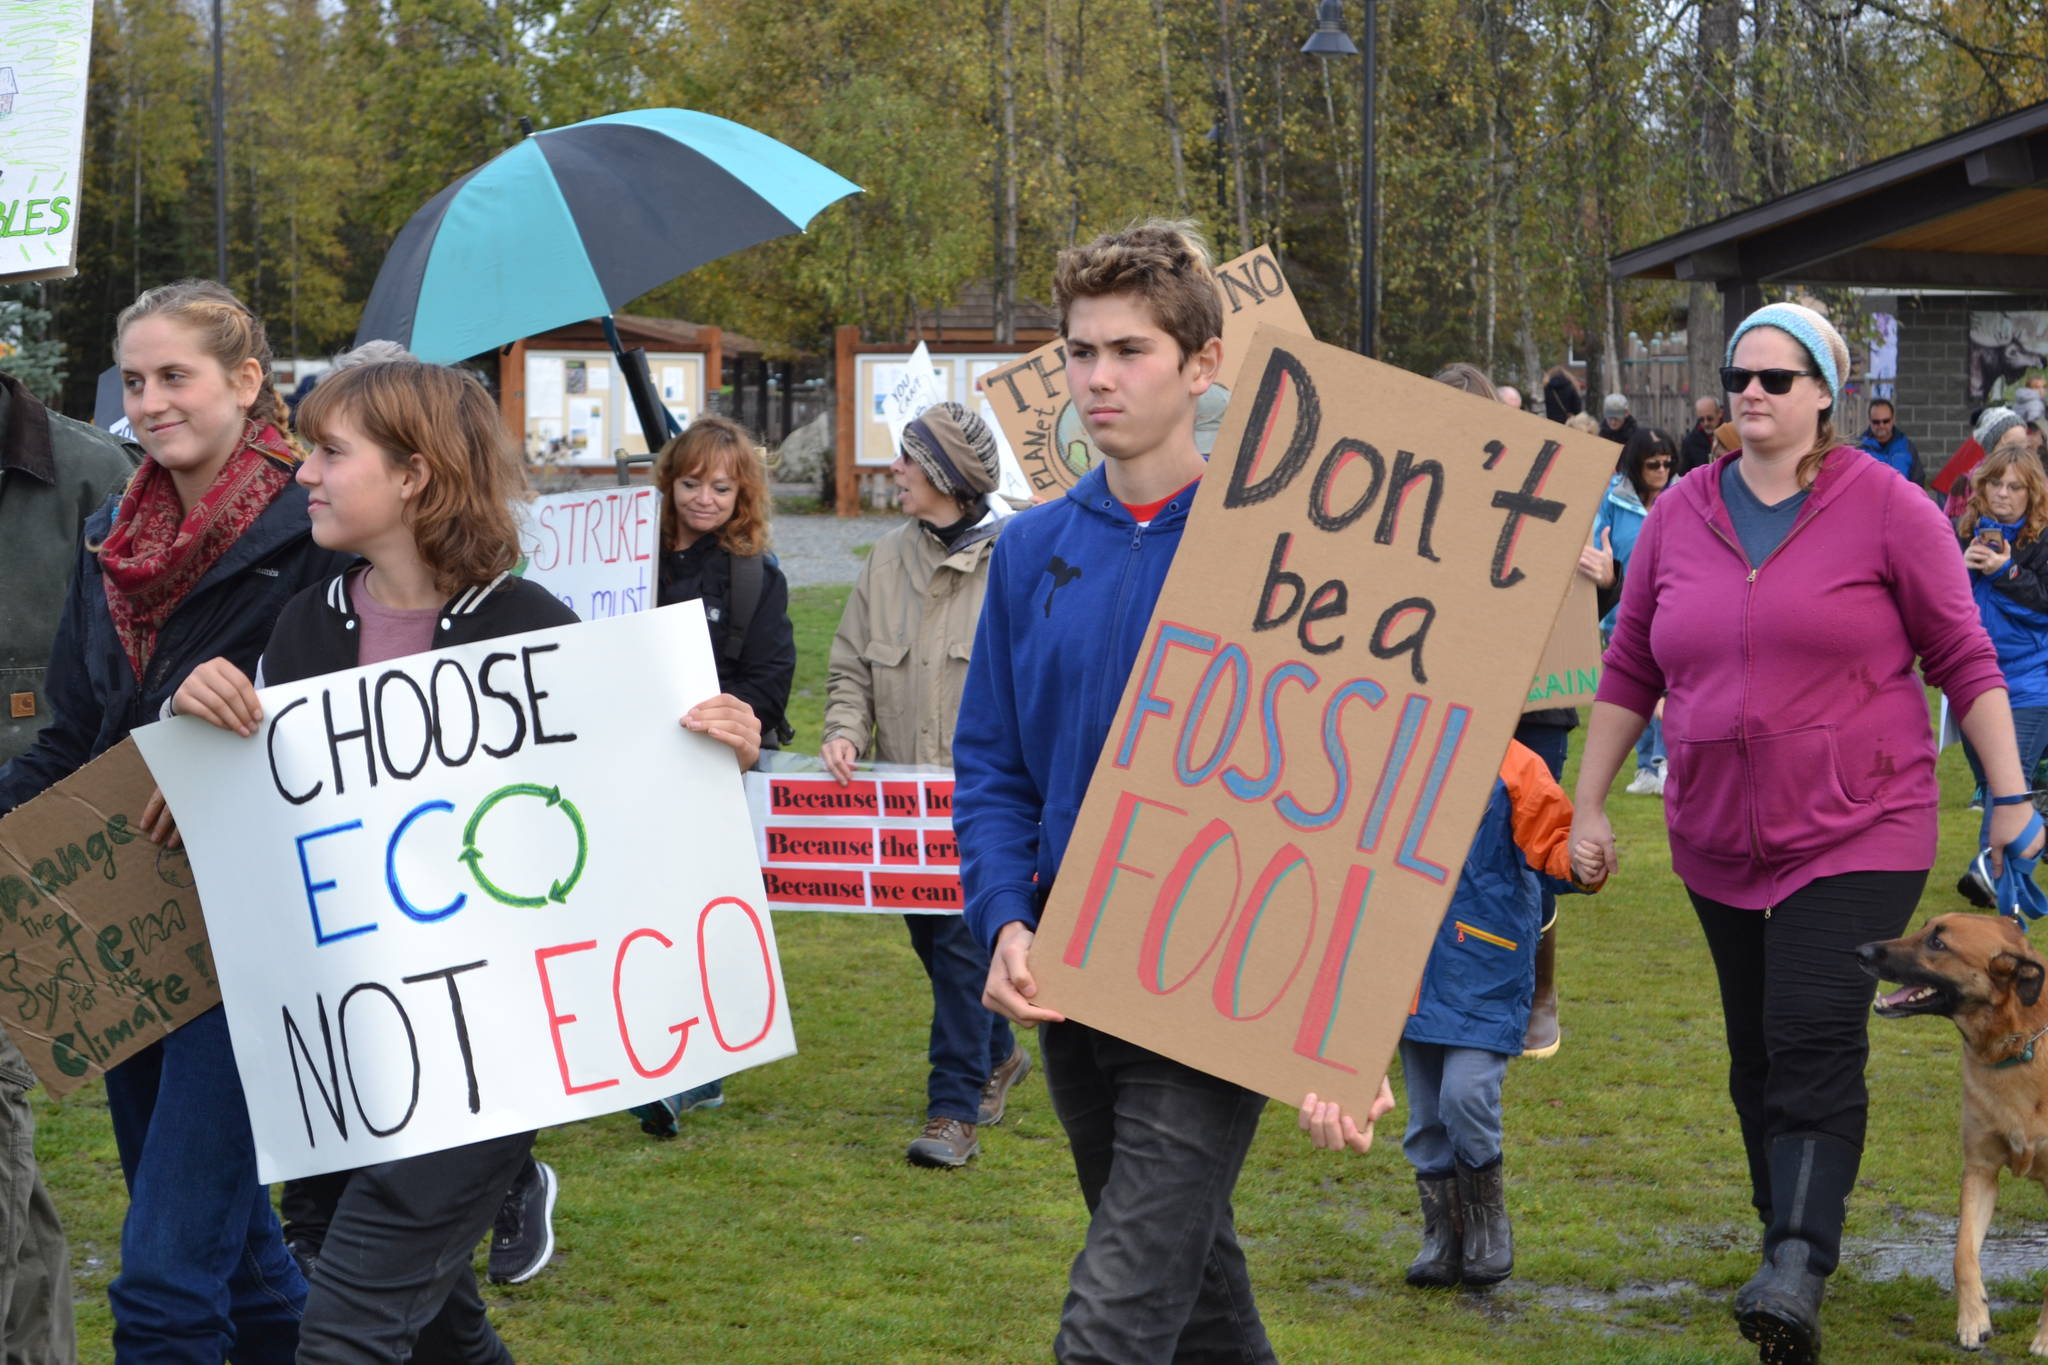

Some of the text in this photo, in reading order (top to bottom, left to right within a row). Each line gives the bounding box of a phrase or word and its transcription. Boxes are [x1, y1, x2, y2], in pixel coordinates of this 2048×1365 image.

[1217, 254, 1285, 313] NO
[891, 374, 912, 402] YOU
[1223, 347, 1566, 590] Don't
[533, 490, 651, 571] STRIKE
[1252, 532, 1437, 683] be a
[268, 643, 577, 805] CHOOSE
[1112, 620, 1471, 885] FOSSIL
[771, 785, 953, 816] Because my ho
[0, 813, 136, 922] hange
[768, 833, 960, 858] Because the cri
[21, 914, 54, 939] the
[762, 873, 866, 899] Because
[872, 885, 905, 900] we
[1062, 791, 1376, 1075] FOOL
[106, 967, 141, 997] the
[281, 896, 775, 1148] NOT EGO
